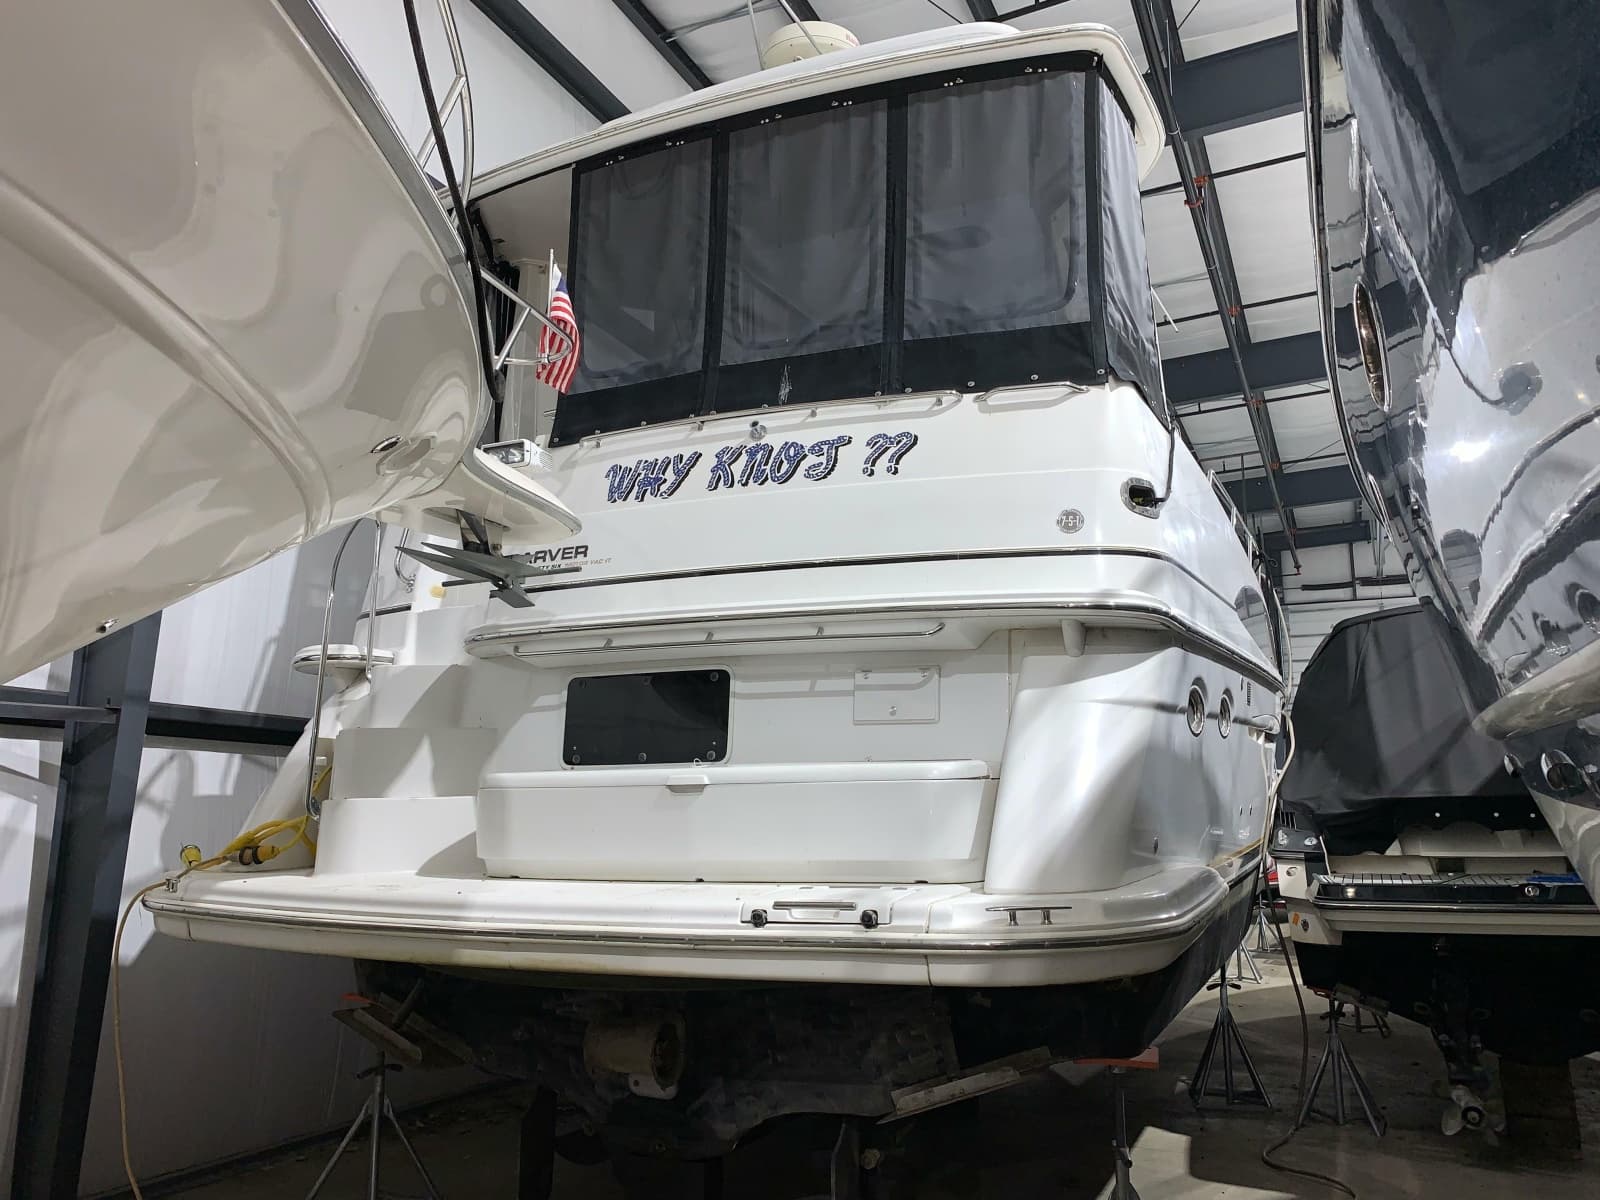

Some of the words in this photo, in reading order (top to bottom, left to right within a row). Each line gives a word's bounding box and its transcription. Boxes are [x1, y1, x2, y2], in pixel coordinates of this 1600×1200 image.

[604, 451, 702, 503] WHY
[705, 434, 852, 490] KNOT
[862, 431, 918, 476] ??
[522, 544, 589, 565] RVER
